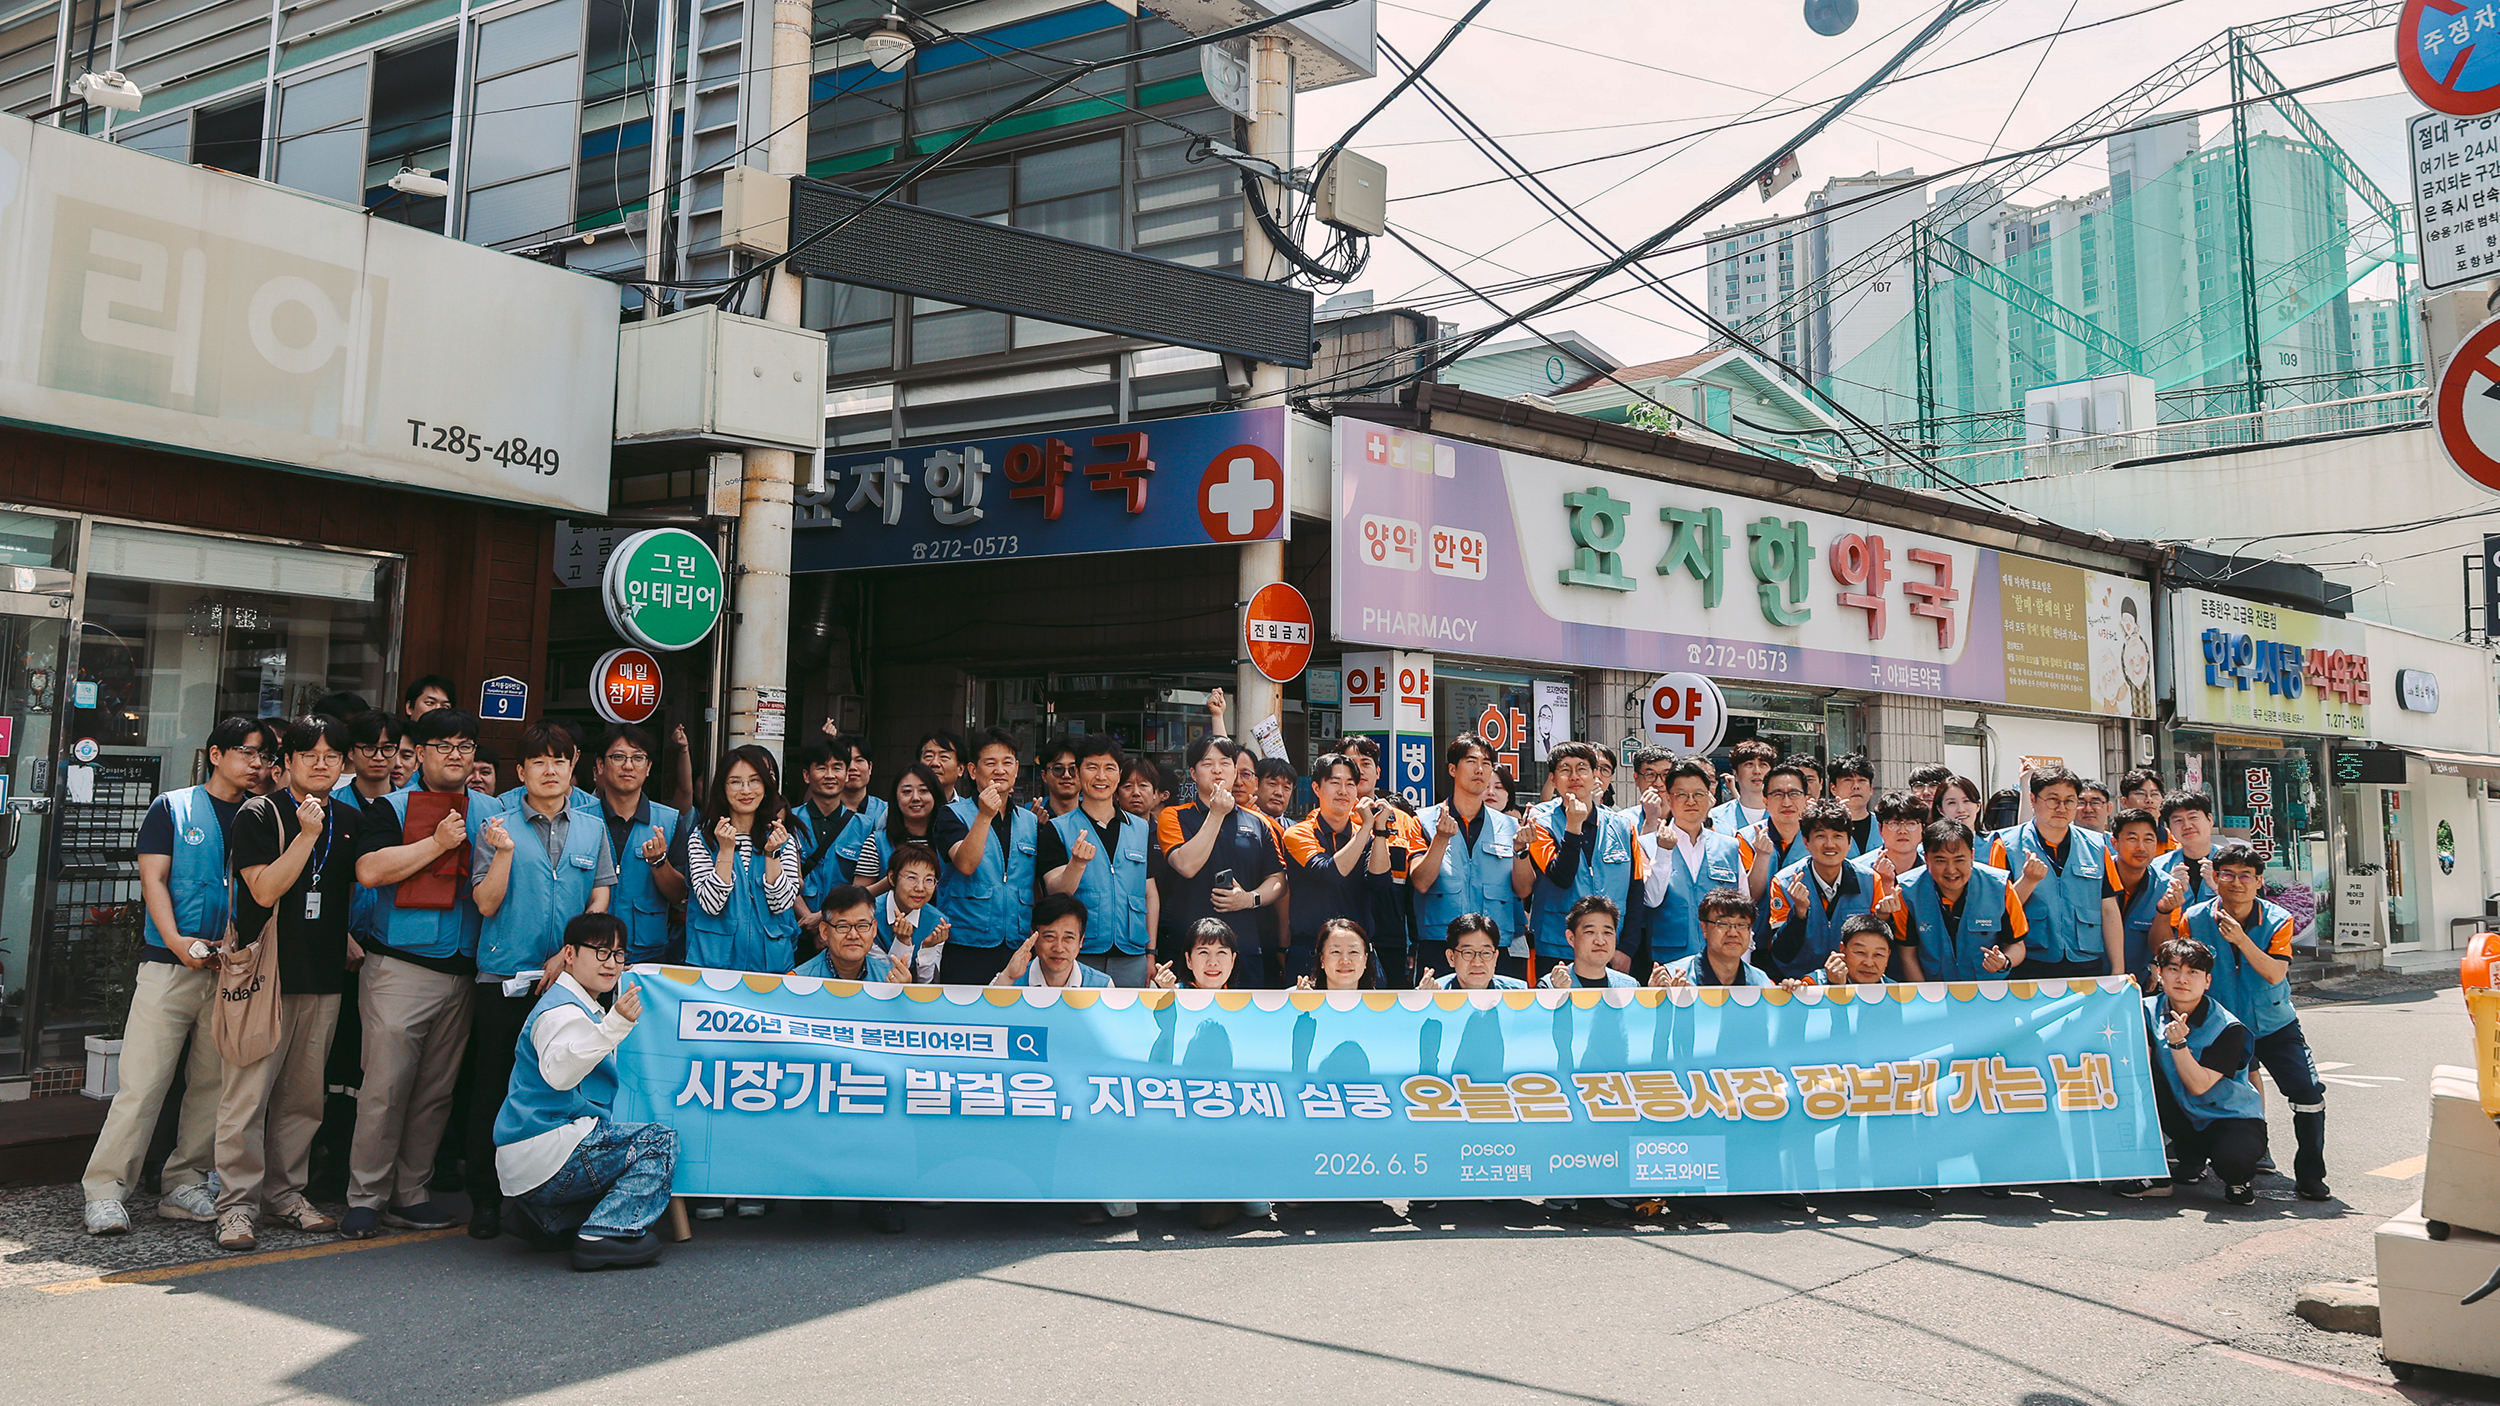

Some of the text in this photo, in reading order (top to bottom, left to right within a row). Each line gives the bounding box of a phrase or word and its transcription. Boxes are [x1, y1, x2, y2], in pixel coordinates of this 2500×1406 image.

[2424, 2, 2500, 55] 주정차
[2418, 119, 2449, 150] 절대
[2420, 136, 2500, 175] 여기는 24시
[2422, 172, 2472, 200] 금지되는
[2424, 186, 2500, 223] 은 즉시 단속
[2426, 211, 2500, 243] (승용 기준 범칙
[1872, 281, 1892, 292] 107
[2278, 305, 2298, 321] SK
[2278, 352, 2298, 367] 109
[406, 419, 560, 477] T.285-4849
[929, 535, 1019, 560] 272-0573
[1363, 520, 1484, 573] 양약 한약
[650, 553, 696, 579] 그린
[1558, 486, 1960, 650] 효자한약국
[628, 580, 716, 612] 인테리어
[2014, 577, 2030, 590] 마지막
[2031, 580, 2052, 594] 토요일은
[1362, 606, 1478, 643] PHARMACY
[2004, 619, 2015, 633] 우리
[2015, 623, 2026, 635] 모두
[2201, 599, 2277, 630] 토종한우 고급육 전문점
[1253, 622, 1309, 642] 진입금지
[619, 662, 648, 681] 매일
[1704, 643, 1788, 673] 272-0573
[2201, 628, 2371, 705] 한우사랑 식육점
[1346, 666, 1388, 719] 약
[1887, 664, 1941, 692] 아파트약국
[498, 698, 508, 714] 9
[609, 682, 656, 705] 참기름
[1399, 668, 1430, 720] 약
[1652, 686, 1702, 748] 약
[2326, 713, 2365, 730] T.277-1514
[1478, 704, 1527, 782] 약
[2246, 767, 2275, 862] 한우사랑
[695, 1009, 994, 1053] 2026년 글로벌 볼런티어위크
[676, 1052, 2118, 1123] 시장가는 발걸음, 지역경제 심쿵 오늘은 전통시장 장보러 가는 날!
[1314, 1152, 1428, 1176] 2026. 6. 5
[1461, 1143, 1516, 1160] posco
[1549, 1150, 1619, 1174] poswel
[1636, 1141, 1689, 1159] posco
[1460, 1163, 1532, 1182] 포스코엠텍
[1635, 1162, 1721, 1181] 포스코와이드
